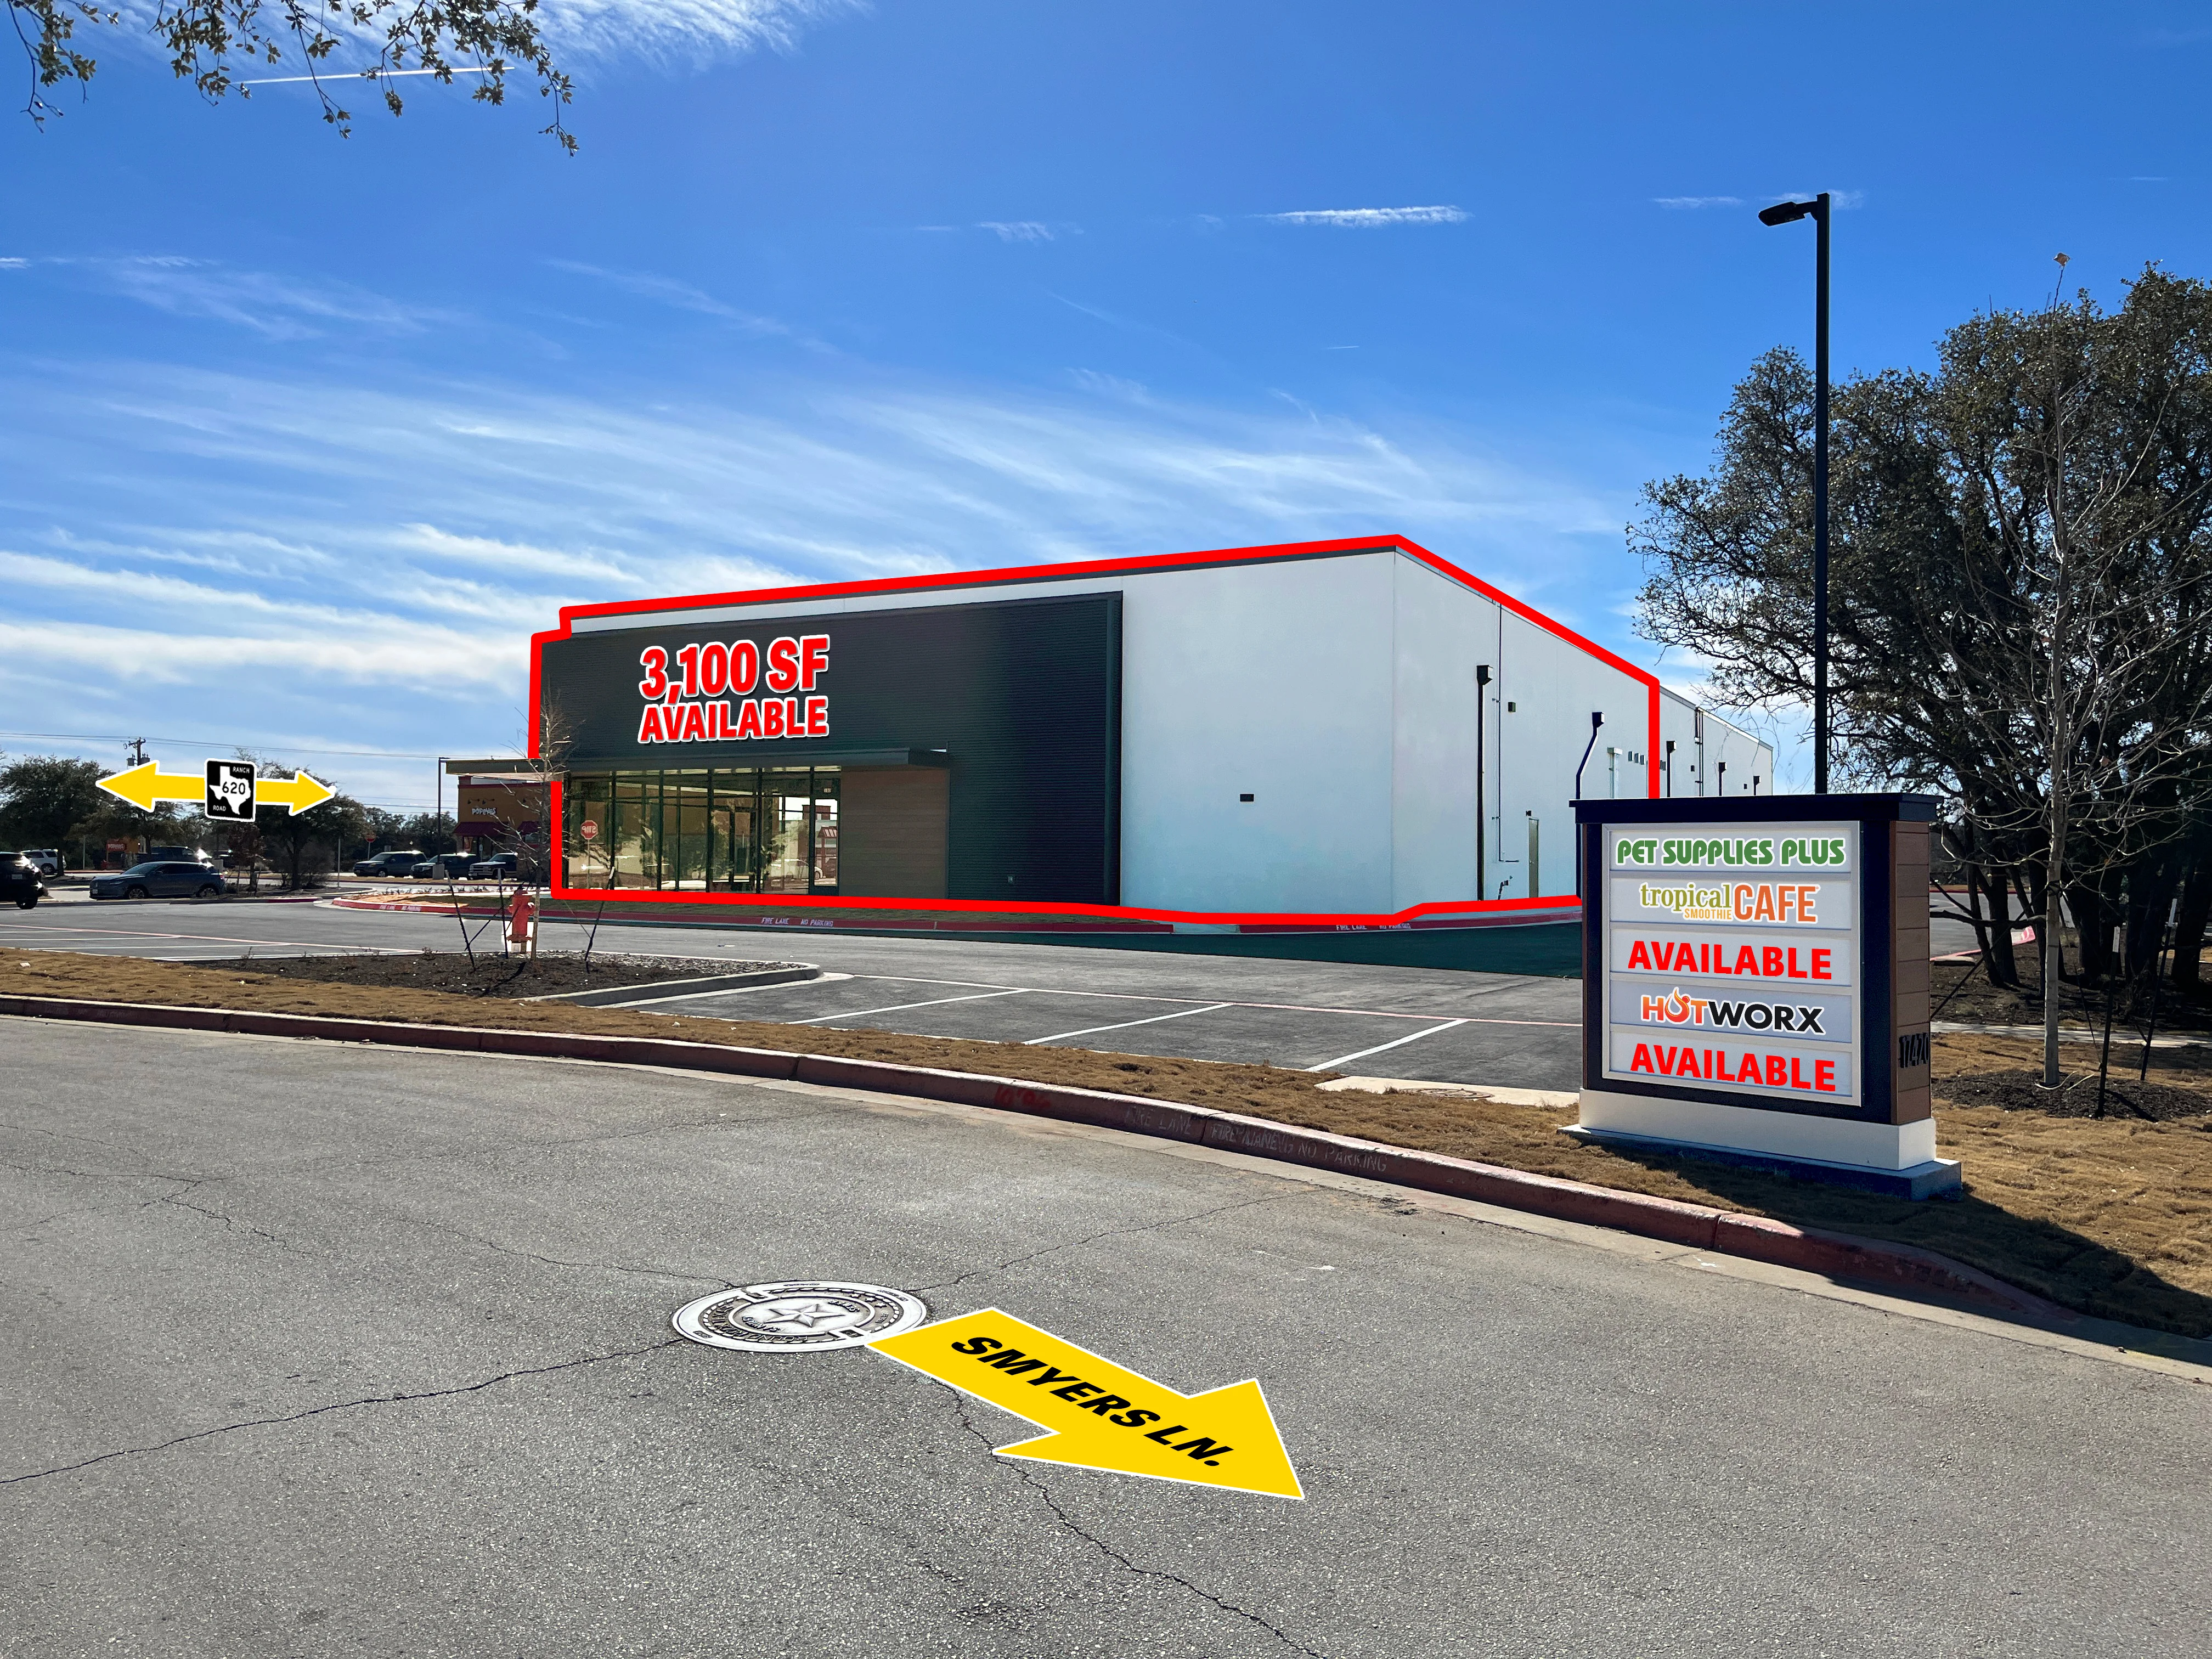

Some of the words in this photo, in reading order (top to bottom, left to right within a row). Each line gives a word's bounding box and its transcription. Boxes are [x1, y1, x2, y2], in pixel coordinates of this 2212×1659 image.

[1617, 839, 1658, 864] PET
[1662, 839, 1774, 865] SUPPLIES
[1781, 839, 1845, 865] PLUS
[1640, 883, 1733, 912] tropical
[1734, 883, 1817, 923] CAFE
[1684, 907, 1733, 920] SMOOTHIE
[810, 919, 834, 927] PARKING
[1627, 940, 1832, 980] AVAILABLE
[1642, 987, 1825, 1034] HOTWORX
[1630, 1042, 1836, 1092] AVAILABLE
[1297, 1140, 1317, 1158] NO
[1325, 1144, 1387, 1173] PARKING
